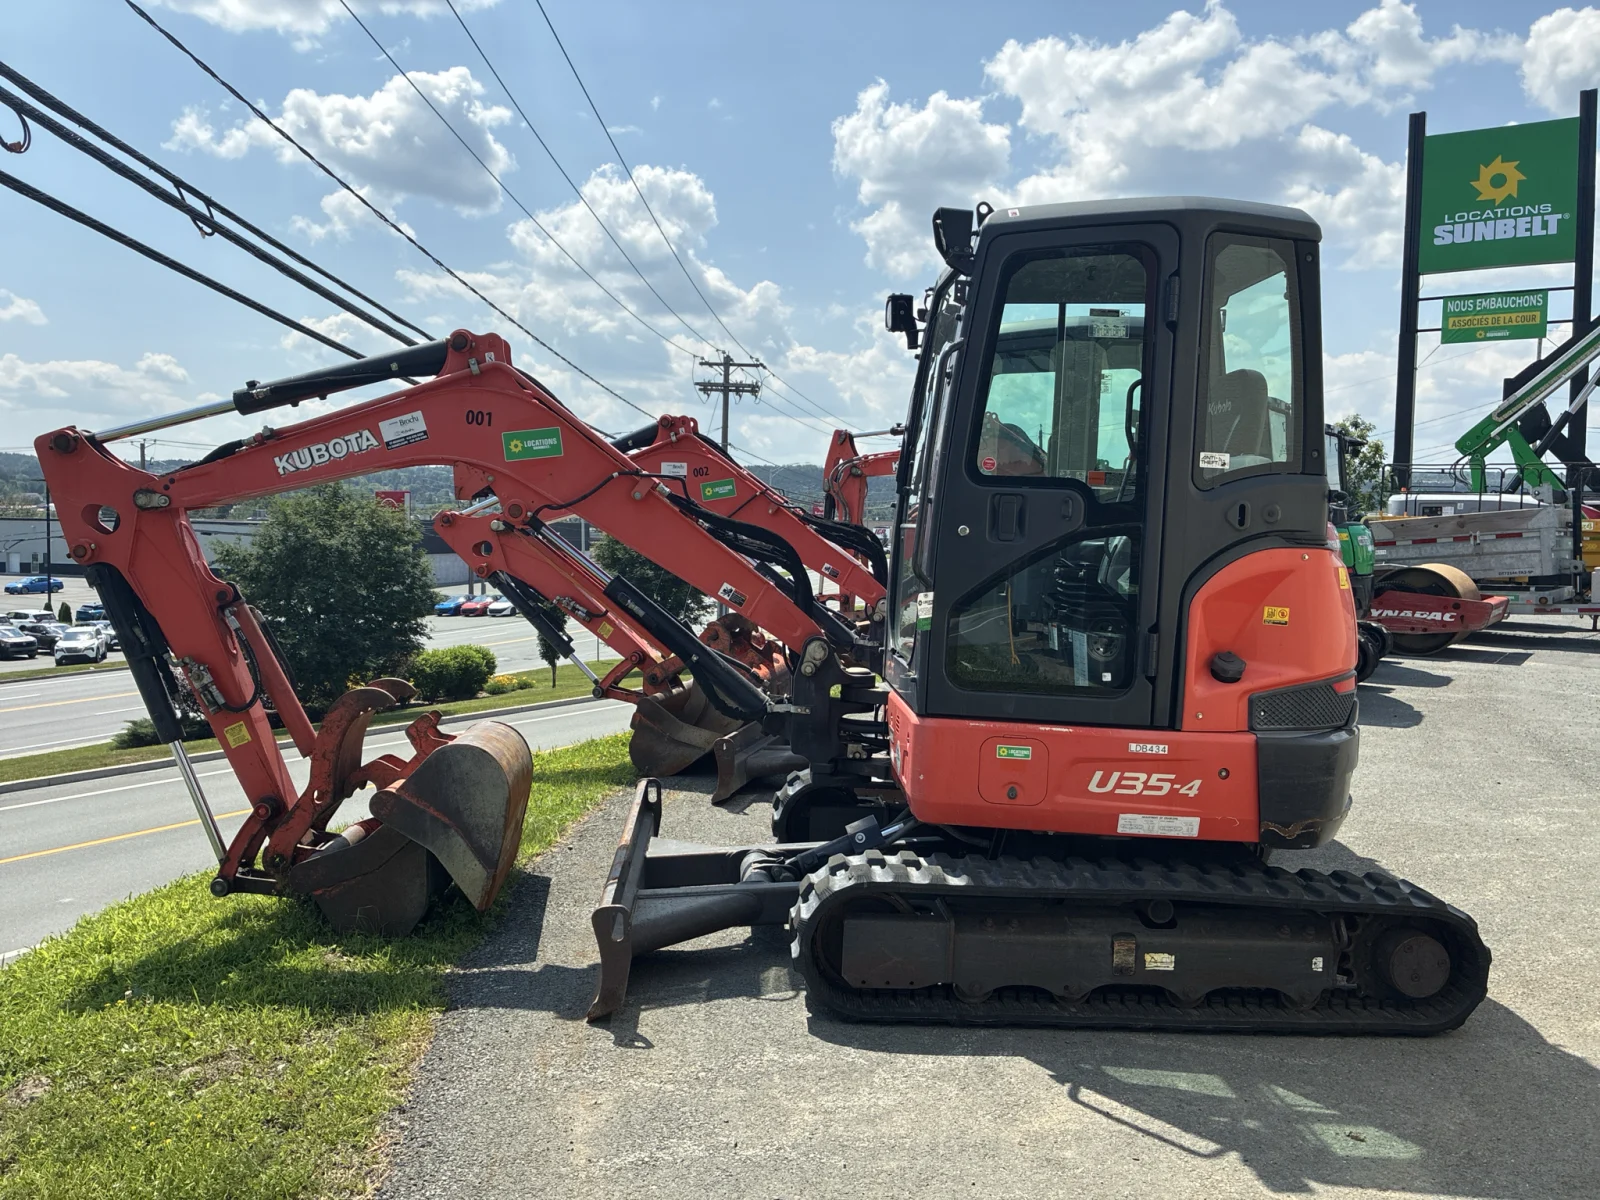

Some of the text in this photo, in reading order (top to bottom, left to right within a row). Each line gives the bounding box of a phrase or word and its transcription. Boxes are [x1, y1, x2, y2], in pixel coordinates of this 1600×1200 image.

[1445, 203, 1552, 223] LOCATIONS
[1433, 213, 1563, 246] SUNBELT
[1447, 294, 1543, 312] NOUS EMBAUCHONS
[1451, 314, 1537, 328] ASSOCIÉS DE LA COUR
[465, 409, 493, 427] 001
[524, 437, 558, 448] LOCATIONS
[273, 428, 380, 476] KUBOTA
[693, 466, 710, 478] 002
[1088, 770, 1203, 798] U35-4
